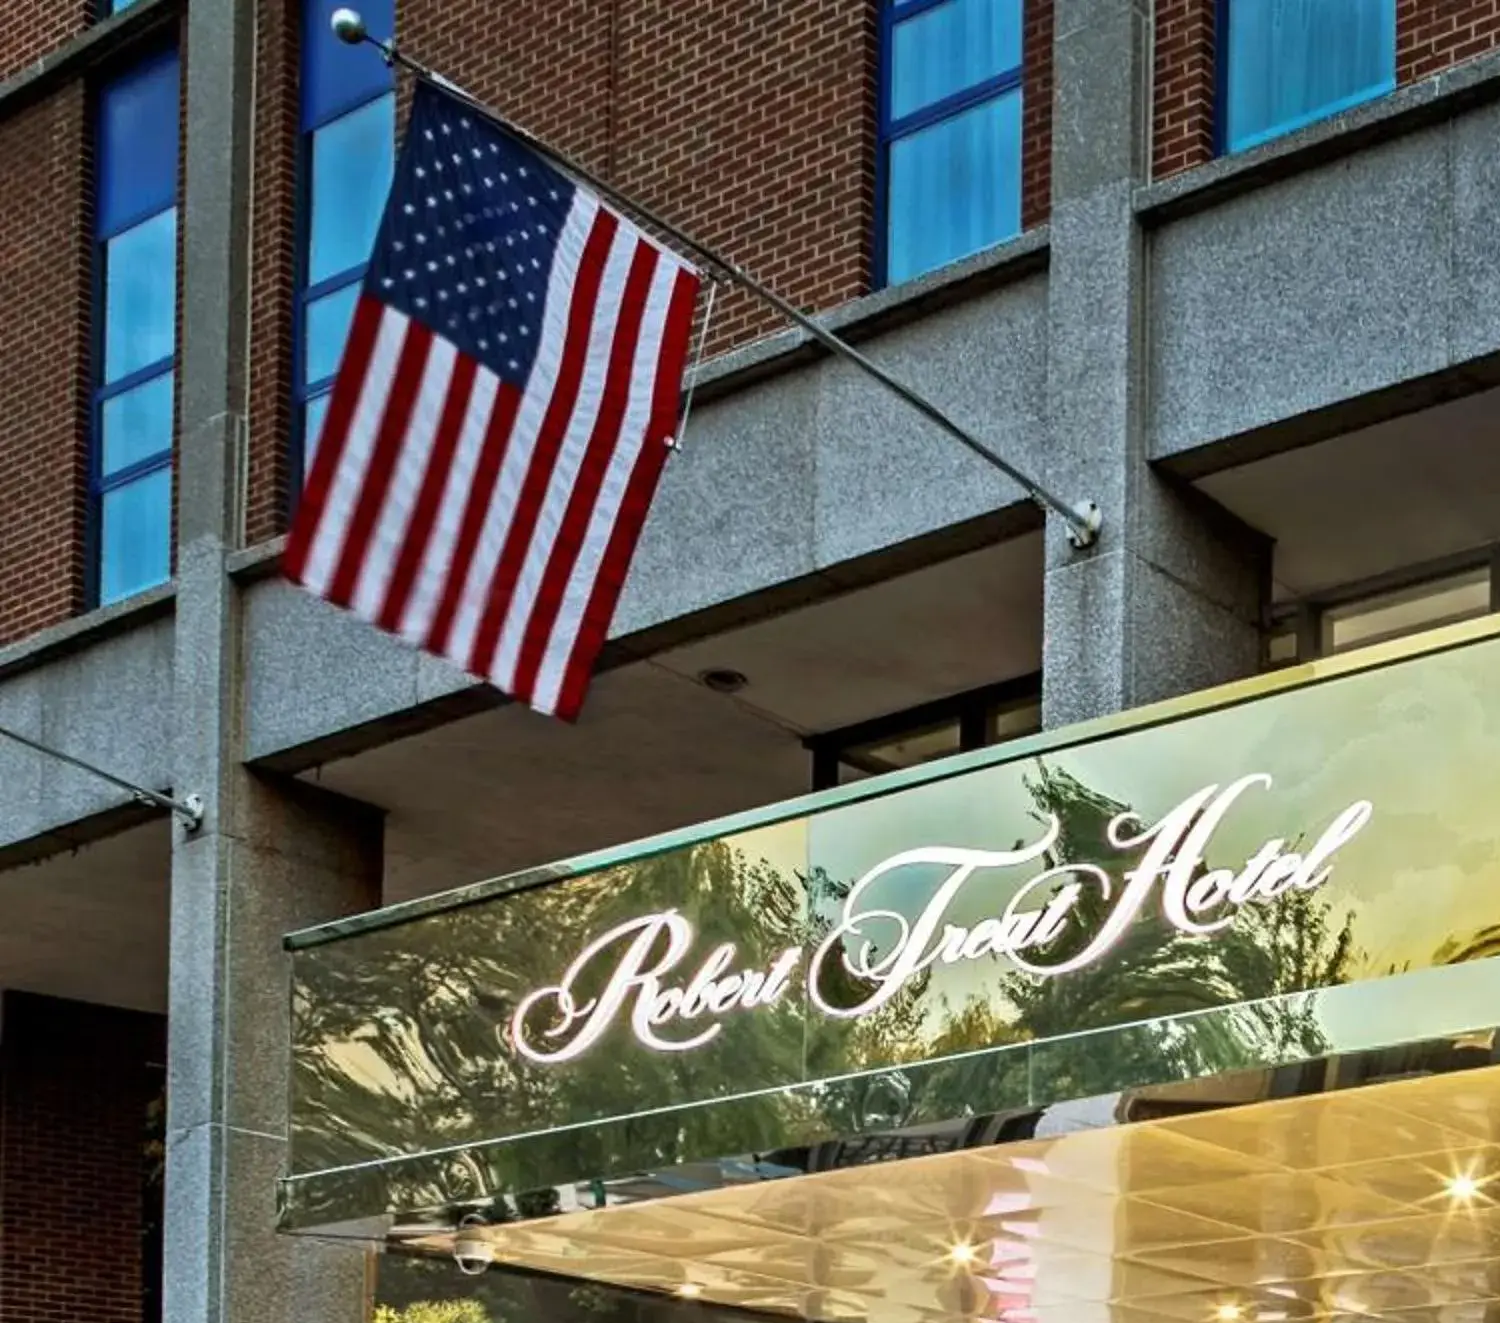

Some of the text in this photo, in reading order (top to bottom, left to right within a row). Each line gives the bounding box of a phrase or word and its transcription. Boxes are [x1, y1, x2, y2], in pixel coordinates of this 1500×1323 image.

[511, 772, 1373, 1063] Robert Treat Hotel
